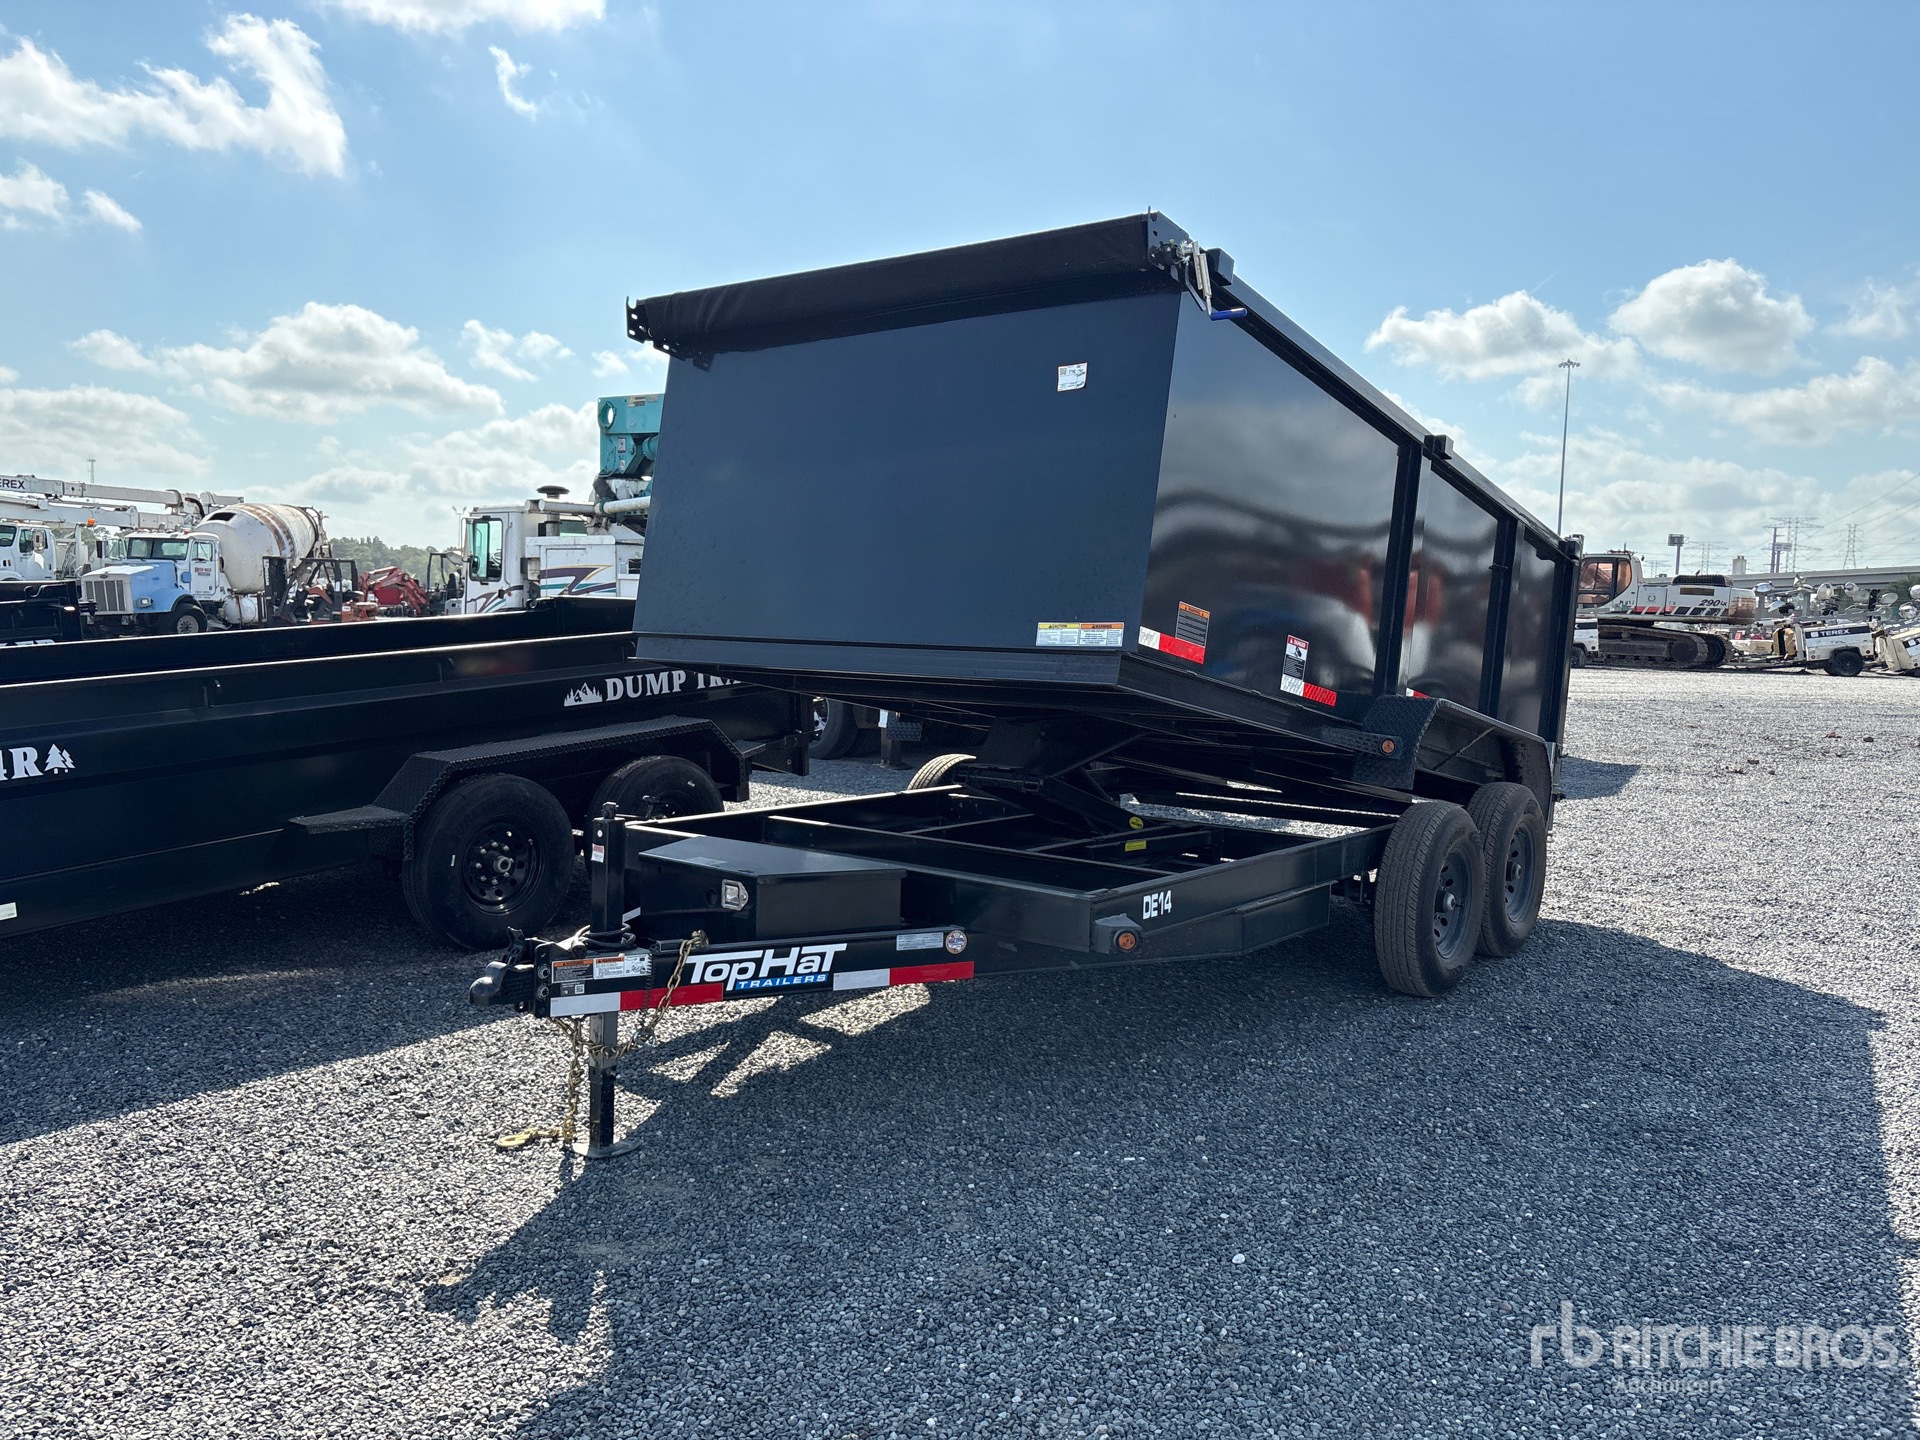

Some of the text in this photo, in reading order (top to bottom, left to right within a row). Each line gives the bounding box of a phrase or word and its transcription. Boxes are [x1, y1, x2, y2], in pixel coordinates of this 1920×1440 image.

[0, 479, 25, 490] REX
[1820, 629, 1850, 637] TEREX
[605, 670, 687, 702] DUMP
[0, 746, 44, 781] R
[1143, 890, 1172, 919] DE14
[739, 974, 827, 989] TRAILERS
